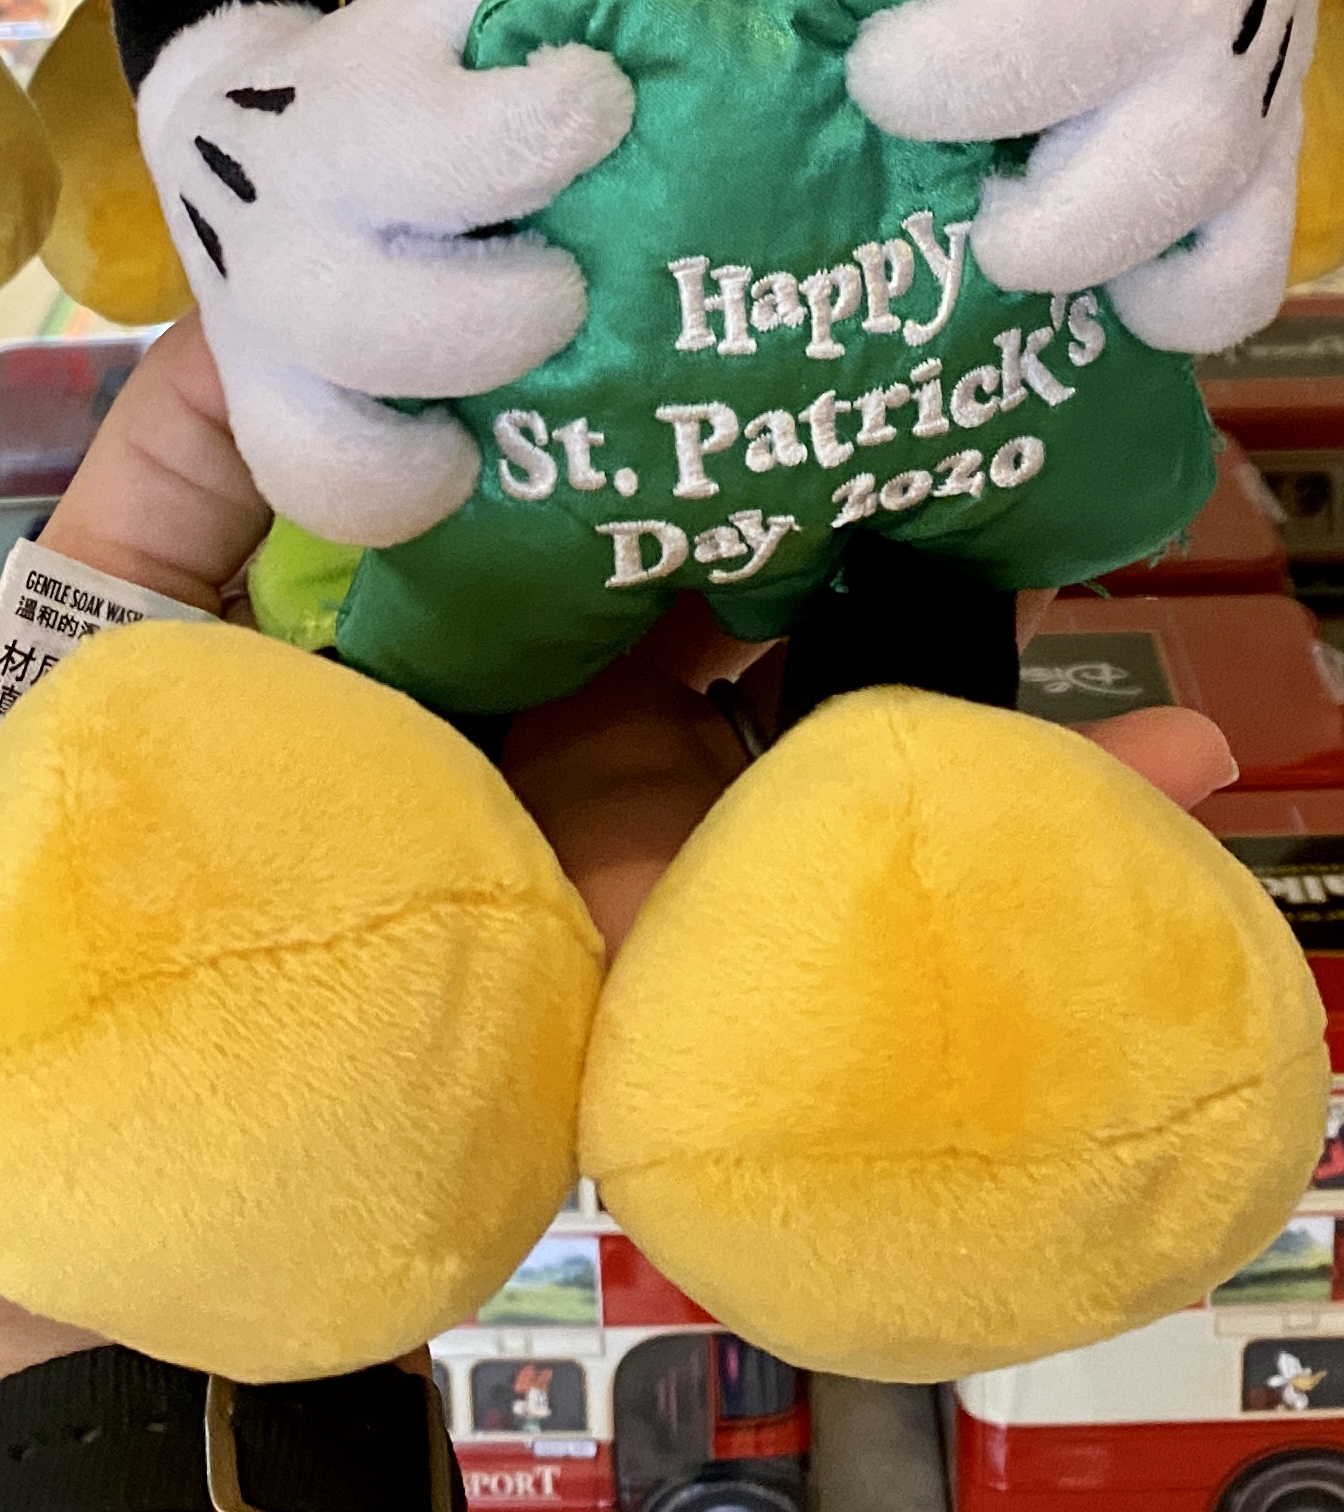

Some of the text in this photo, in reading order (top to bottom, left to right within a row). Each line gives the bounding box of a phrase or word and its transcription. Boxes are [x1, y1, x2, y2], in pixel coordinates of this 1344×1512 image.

[667, 209, 973, 359] Happy
[492, 288, 1106, 501] St. Patrick's
[595, 435, 1046, 588] Day 2020
[26, 570, 72, 605] GENTLE
[69, 588, 104, 618] SOAK
